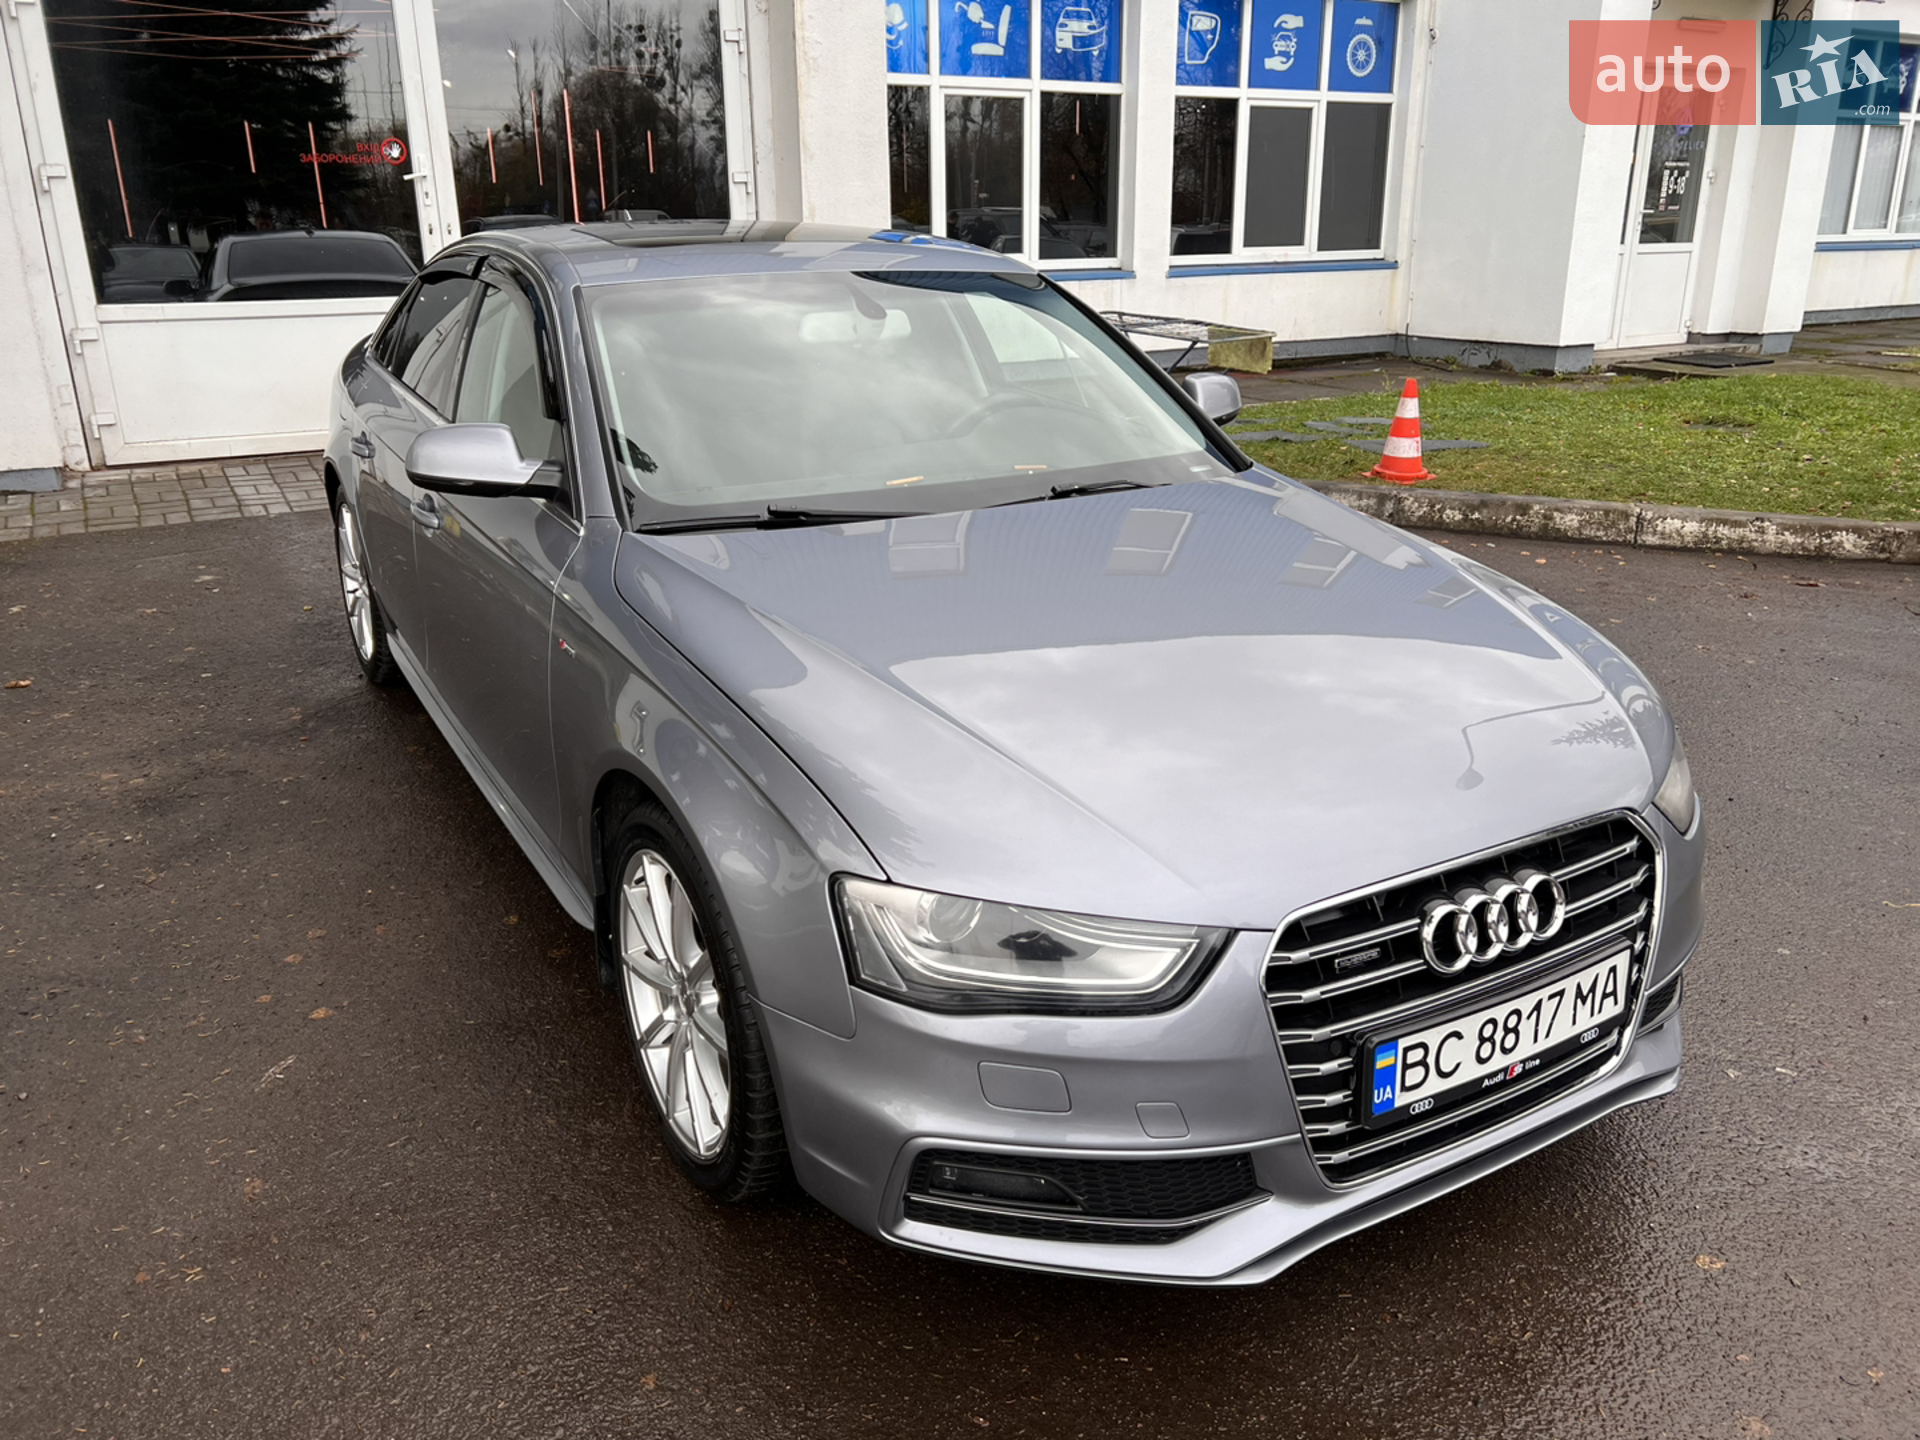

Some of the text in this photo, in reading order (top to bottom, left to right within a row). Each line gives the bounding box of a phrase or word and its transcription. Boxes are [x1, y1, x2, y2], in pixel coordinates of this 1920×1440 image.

[1400, 965, 1620, 1093] BC 8817 MA
[1481, 1071, 1505, 1088] Audi
[1525, 1058, 1541, 1070] line
[1373, 1084, 1393, 1104] UA
